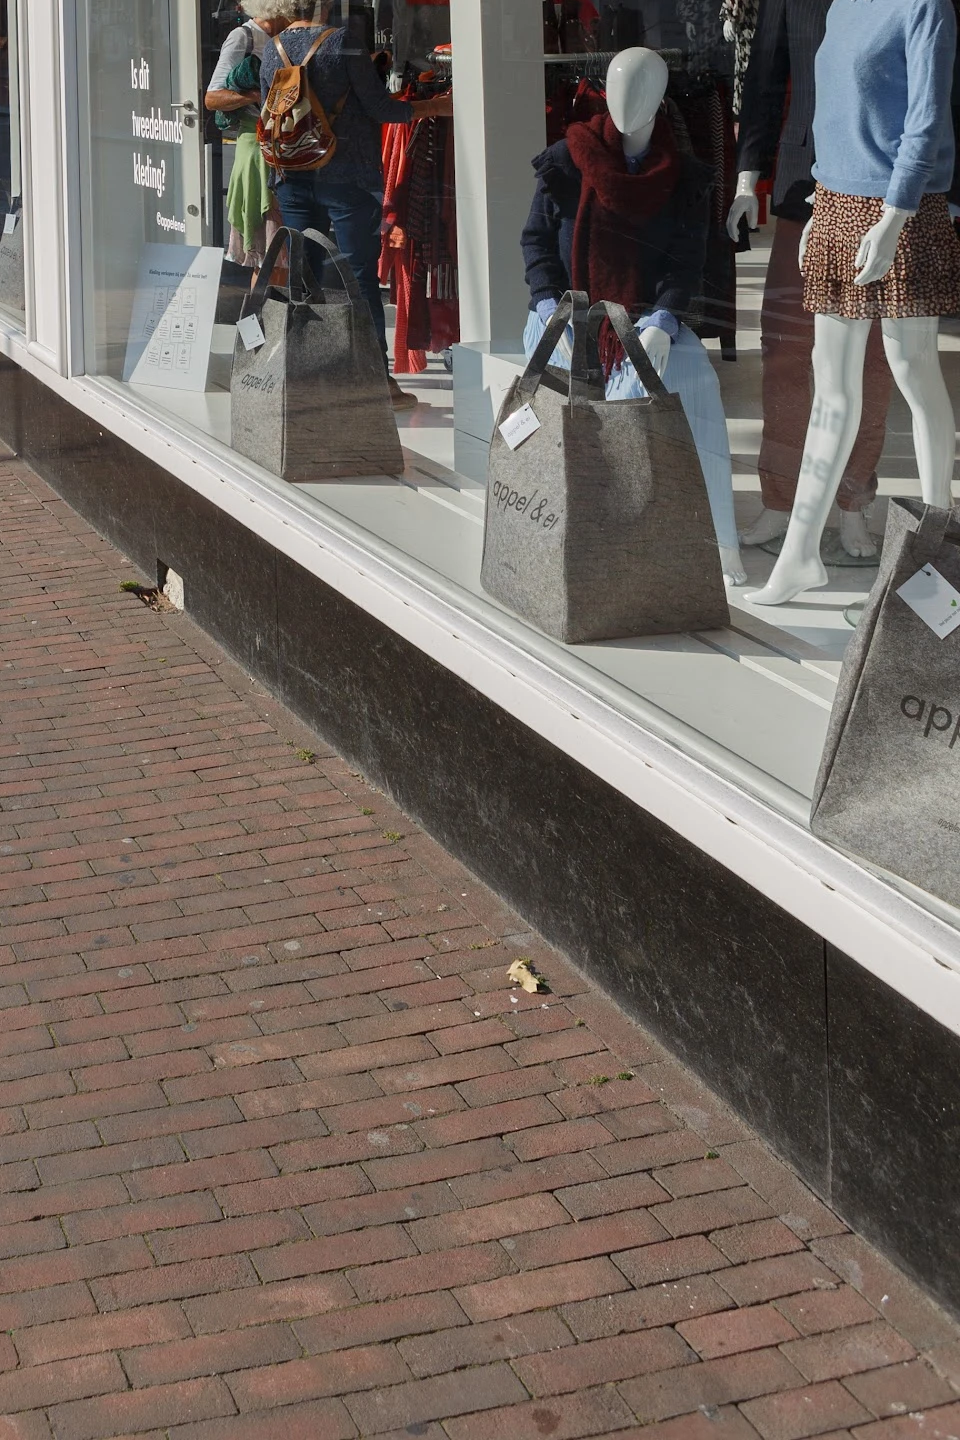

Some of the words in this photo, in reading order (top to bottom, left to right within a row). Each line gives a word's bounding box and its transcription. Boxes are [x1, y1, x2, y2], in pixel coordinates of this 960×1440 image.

[130, 59, 138, 89] Is
[139, 57, 150, 90] dit
[132, 107, 183, 144] tweedehands
[133, 152, 166, 197] kleding?
[493, 480, 539, 514] appel
[530, 498, 548, 523] &
[543, 509, 564, 530] ei
